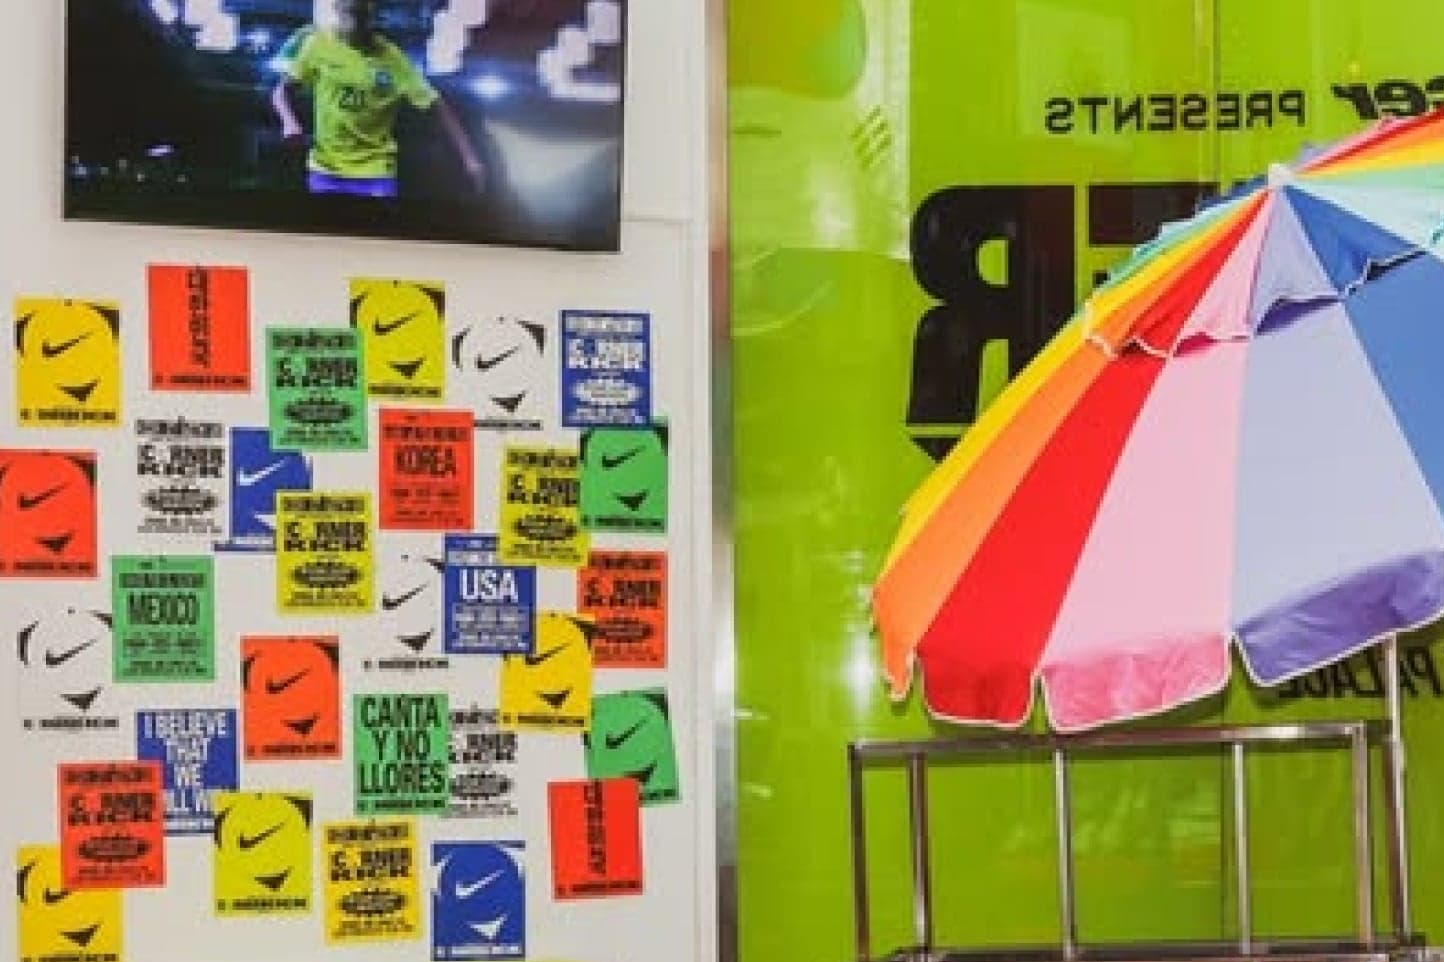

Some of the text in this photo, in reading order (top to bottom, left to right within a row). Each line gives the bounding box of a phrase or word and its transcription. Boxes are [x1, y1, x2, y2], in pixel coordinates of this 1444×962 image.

[567, 339, 646, 361] CRNER
[276, 357, 358, 376] CRNER
[137, 444, 224, 465] CRNER
[396, 446, 456, 477] KOREA
[508, 475, 580, 496] CRNER
[284, 522, 366, 543] CRNER
[461, 569, 518, 600] USA
[584, 580, 661, 599] CRNER
[128, 592, 198, 626] MEXICO
[361, 697, 439, 728] CANTA
[145, 714, 152, 738] I
[154, 713, 228, 737] BELIEVE
[165, 738, 211, 762] THAT
[375, 730, 431, 760] Y NO
[175, 764, 202, 787] WE
[358, 763, 445, 794] LLORES
[69, 792, 155, 813] CRNER
[330, 848, 412, 870] CRNER
